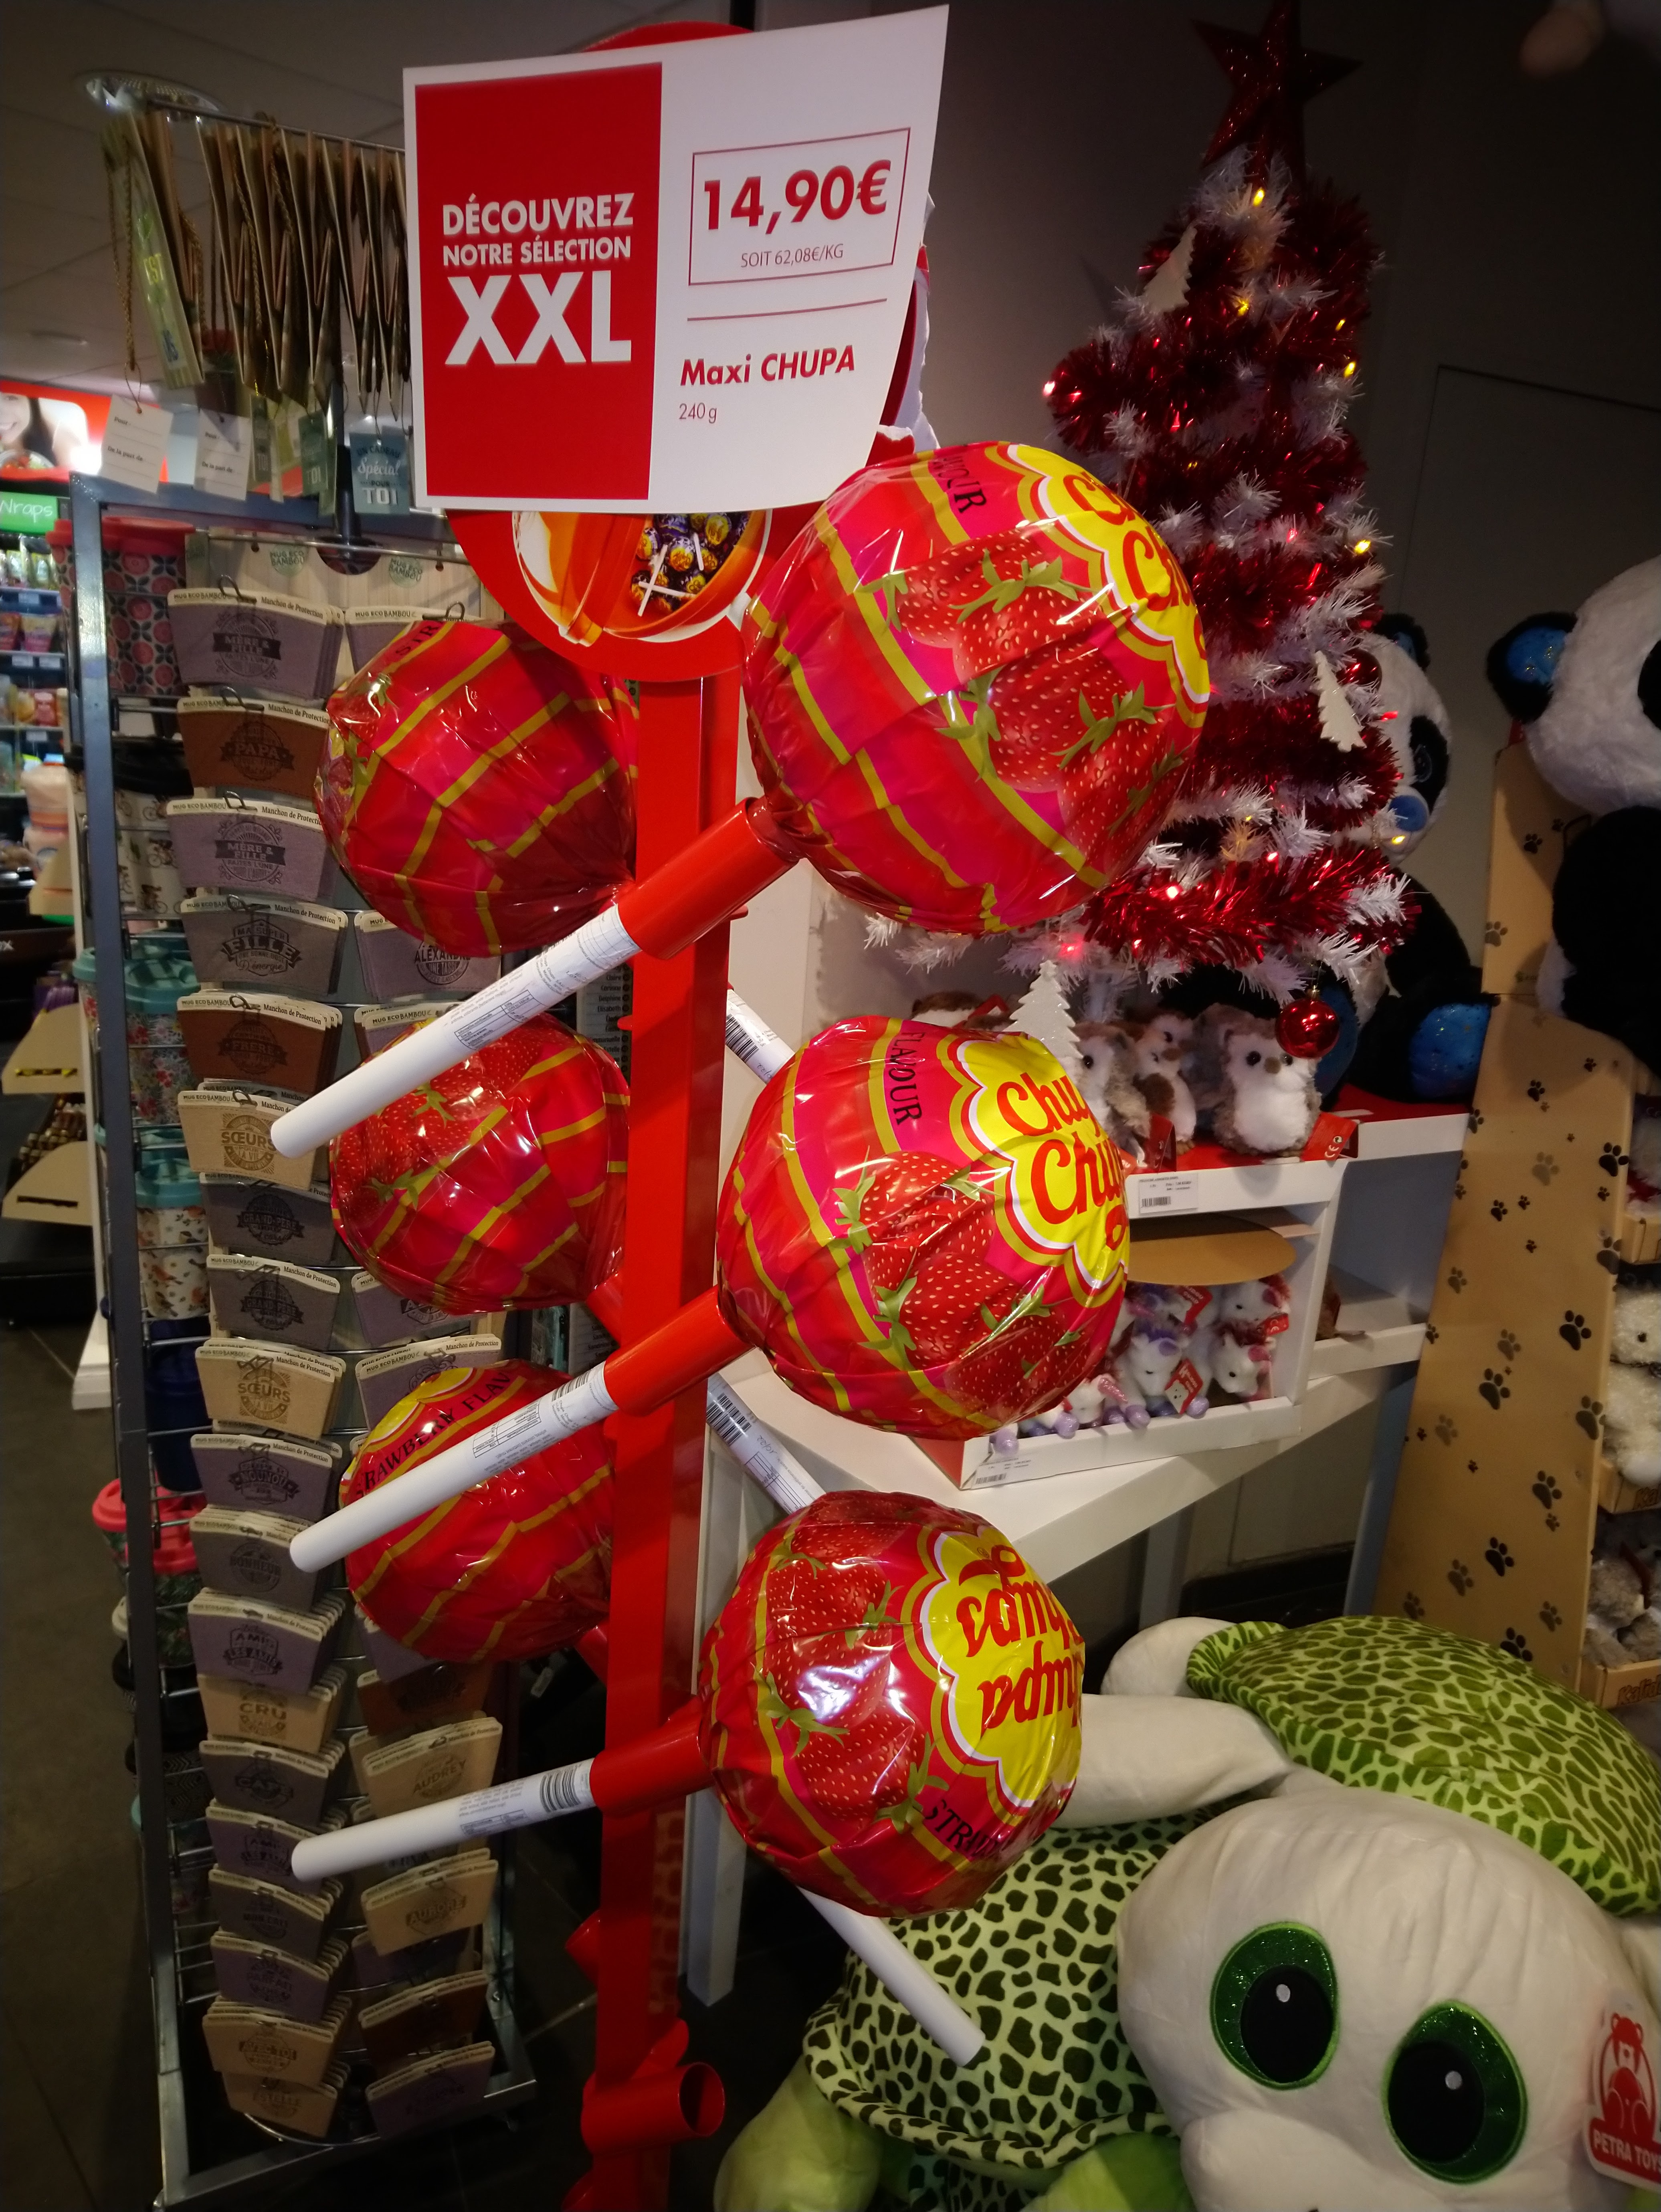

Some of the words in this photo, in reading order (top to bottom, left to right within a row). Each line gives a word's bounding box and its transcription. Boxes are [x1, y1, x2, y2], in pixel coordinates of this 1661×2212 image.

[703, 160, 891, 235] 14,90€
[443, 193, 634, 235] DÉCOUVREZ
[443, 242, 513, 266] NOTRE
[520, 235, 631, 264] SÉLECTION
[740, 249, 772, 268] SOIT
[774, 244, 844, 267] 62,08€/KG
[445, 270, 632, 365] XXL
[680, 354, 751, 387] Maxi
[760, 345, 855, 381] CHUPA
[678, 403, 704, 421] 240
[707, 407, 717, 424] g
[358, 456, 401, 479] Spécial
[363, 487, 398, 505] TOI
[261, 596, 286, 608] Manchon
[295, 603, 323, 619] Protection
[268, 703, 293, 715] Manchon
[235, 741, 279, 759] PAPA
[262, 806, 288, 817] Manchon
[234, 851, 267, 860] FILLE
[275, 904, 300, 916] Manchon
[308, 910, 336, 924] Protection
[228, 936, 295, 959] FILLE
[264, 1004, 288, 1015] Manchon
[296, 1011, 322, 1025] Protection
[400, 1010, 426, 1019] BAMBOU
[888, 1031, 922, 1126] FLAVOUR
[262, 1100, 284, 1112] Manchon
[284, 1265, 305, 1277] Manchon
[313, 1272, 337, 1288] Protection
[361, 1277, 374, 1285] MUG
[446, 1342, 468, 1351] Manchon
[277, 1356, 299, 1367] Manchon
[306, 1364, 331, 1377] Protection
[392, 1352, 415, 1365] BAMBOU
[238, 1382, 291, 1402] SŒURS
[273, 1443, 296, 1453] Manchon
[304, 1449, 328, 1463] Protection
[413, 1758, 467, 1793] AUDREY
[1594, 2128, 1632, 2162] PETRA
